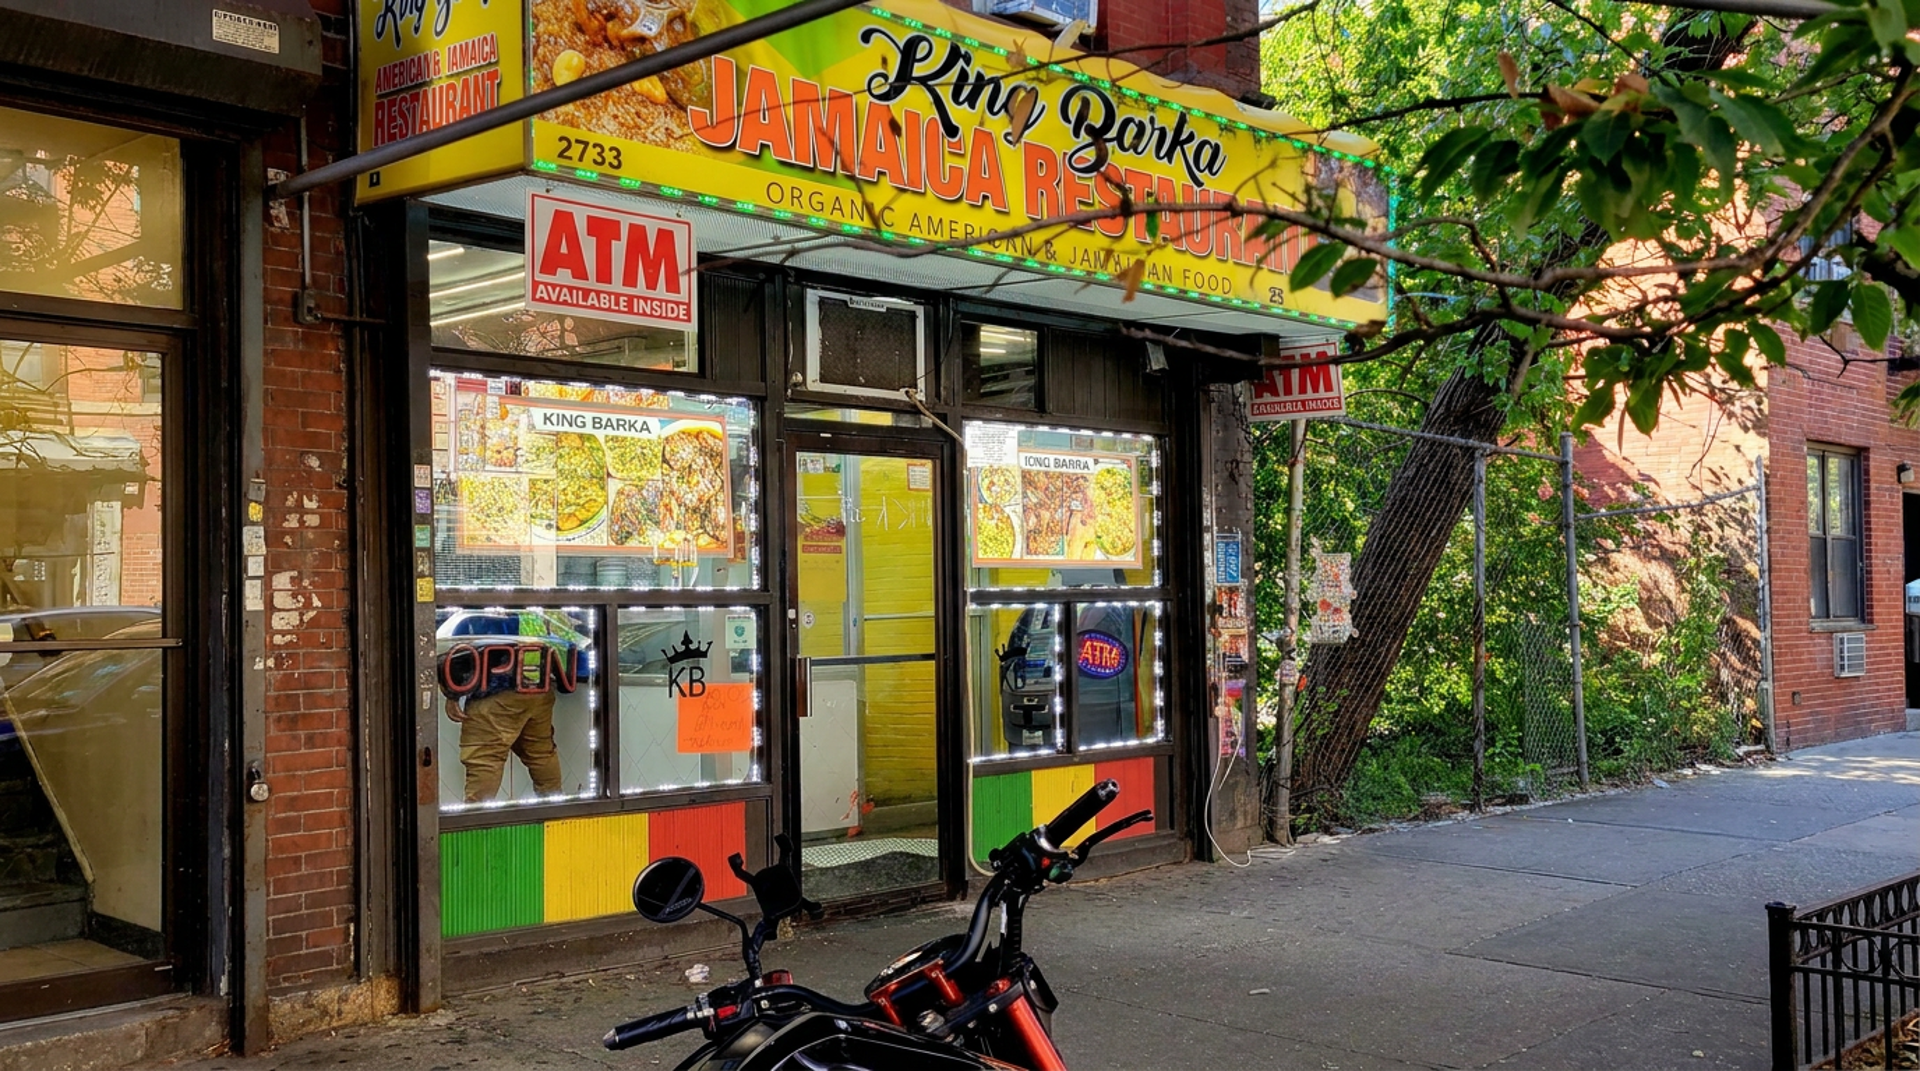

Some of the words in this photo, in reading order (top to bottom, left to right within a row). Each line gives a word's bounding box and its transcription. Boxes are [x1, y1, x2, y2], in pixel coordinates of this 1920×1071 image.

[373, 68, 500, 147] RESTAURANT
[860, 27, 1046, 144] King
[1060, 84, 1227, 188] Barka
[556, 135, 623, 170] 2733
[687, 55, 1009, 212] JAMAICA
[1022, 140, 1320, 275] RESTAURAN
[539, 209, 681, 295] ATM
[1045, 240, 1057, 262] &
[1183, 269, 1232, 295] FOOD
[535, 284, 628, 311] AVAILABLE
[633, 302, 688, 319] INSIDE
[1253, 351, 1334, 399] ATM
[542, 412, 587, 429] KING
[591, 417, 652, 434] BARKA
[442, 643, 577, 694] OPEN
[668, 666, 706, 698] KB
